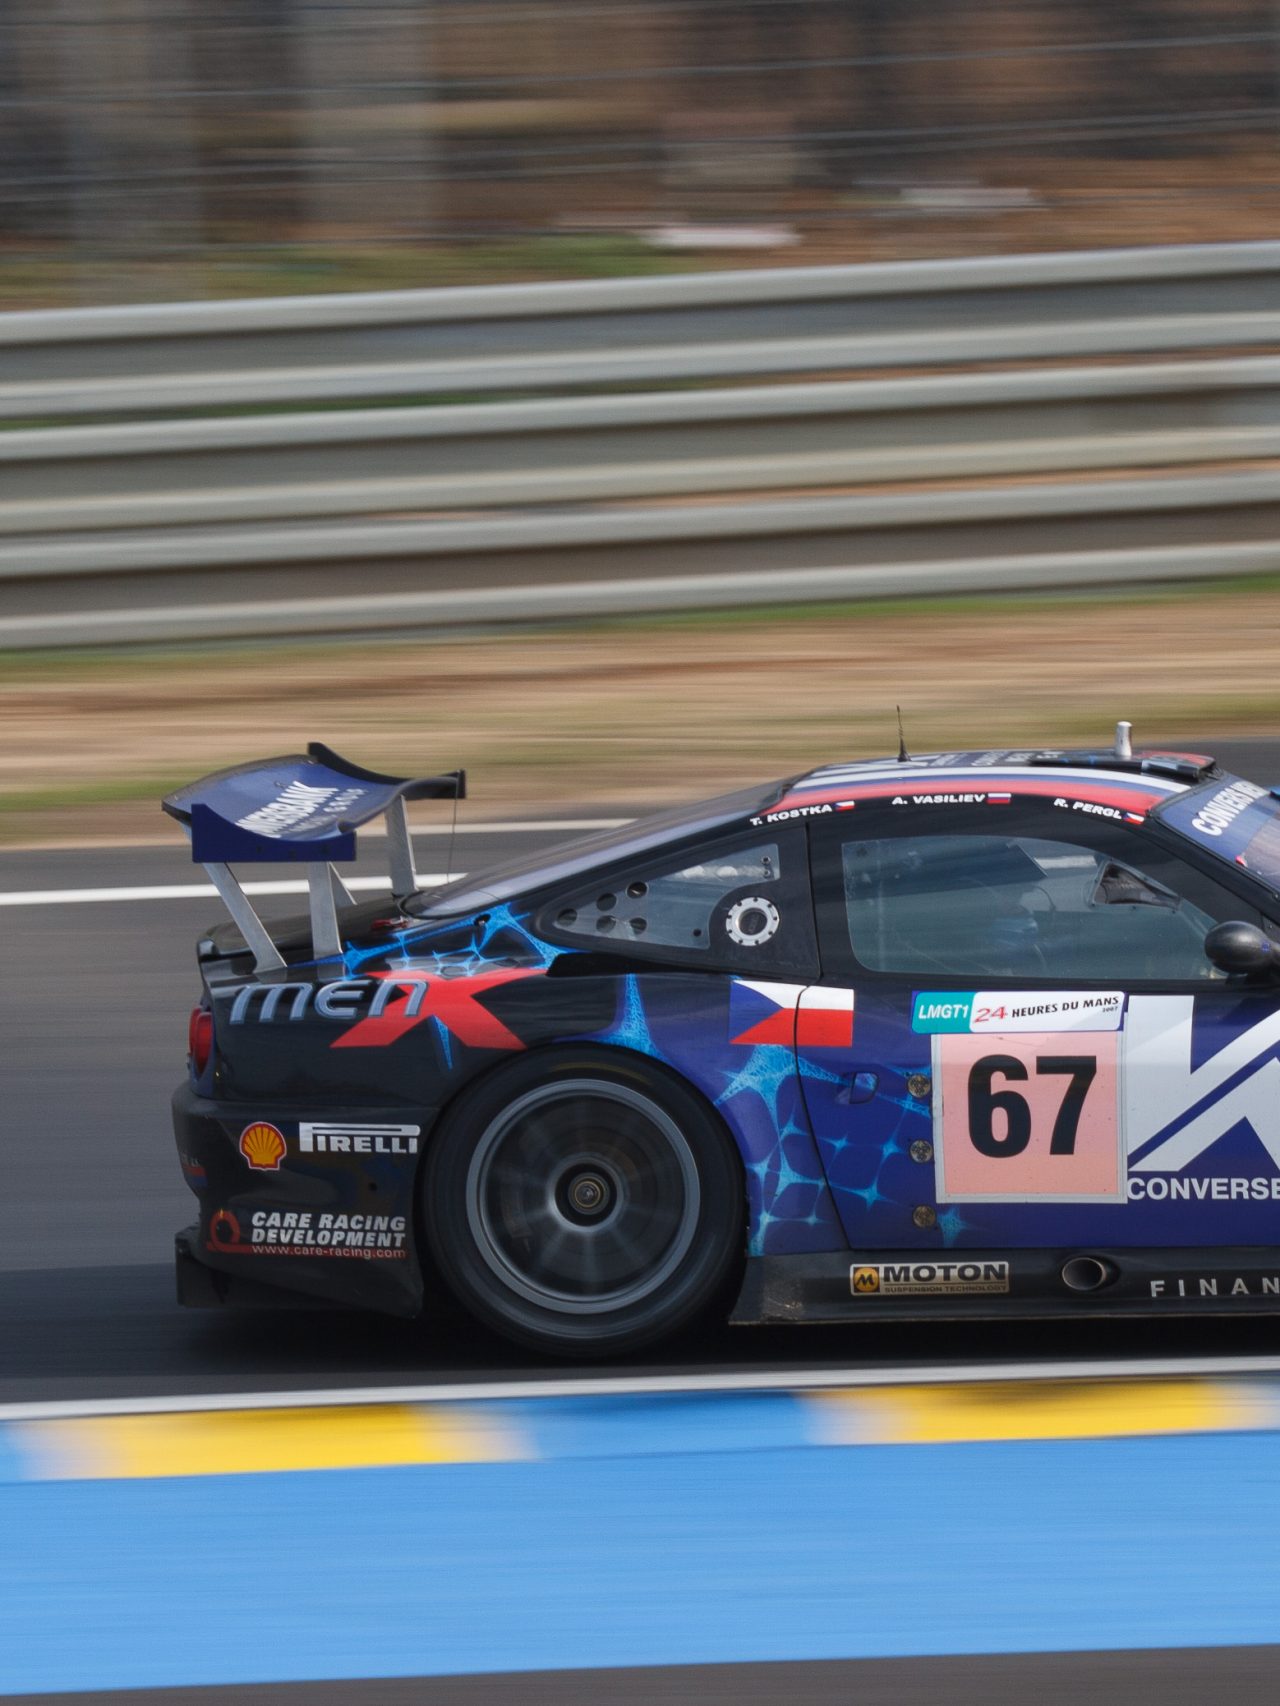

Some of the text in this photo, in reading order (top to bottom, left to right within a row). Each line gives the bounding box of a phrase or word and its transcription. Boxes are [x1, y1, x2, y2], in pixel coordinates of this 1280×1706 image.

[892, 793, 986, 806] A. VASILIEV
[1053, 797, 1122, 820] R. PERGL
[749, 804, 833, 827] T. KOSTKA
[918, 1003, 969, 1020] LMGT1
[974, 996, 1120, 1024] 24 HEURES DU MANS
[966, 1054, 1098, 1158] 67
[299, 1122, 421, 1154] PIRELLI
[251, 1211, 406, 1231] CARE RACING
[251, 1228, 406, 1247] DEVELOPMENT
[251, 1245, 407, 1260] www.care-racing.com
[883, 1263, 1006, 1283] MOTON
[884, 1285, 943, 1294] SUSPENSION
